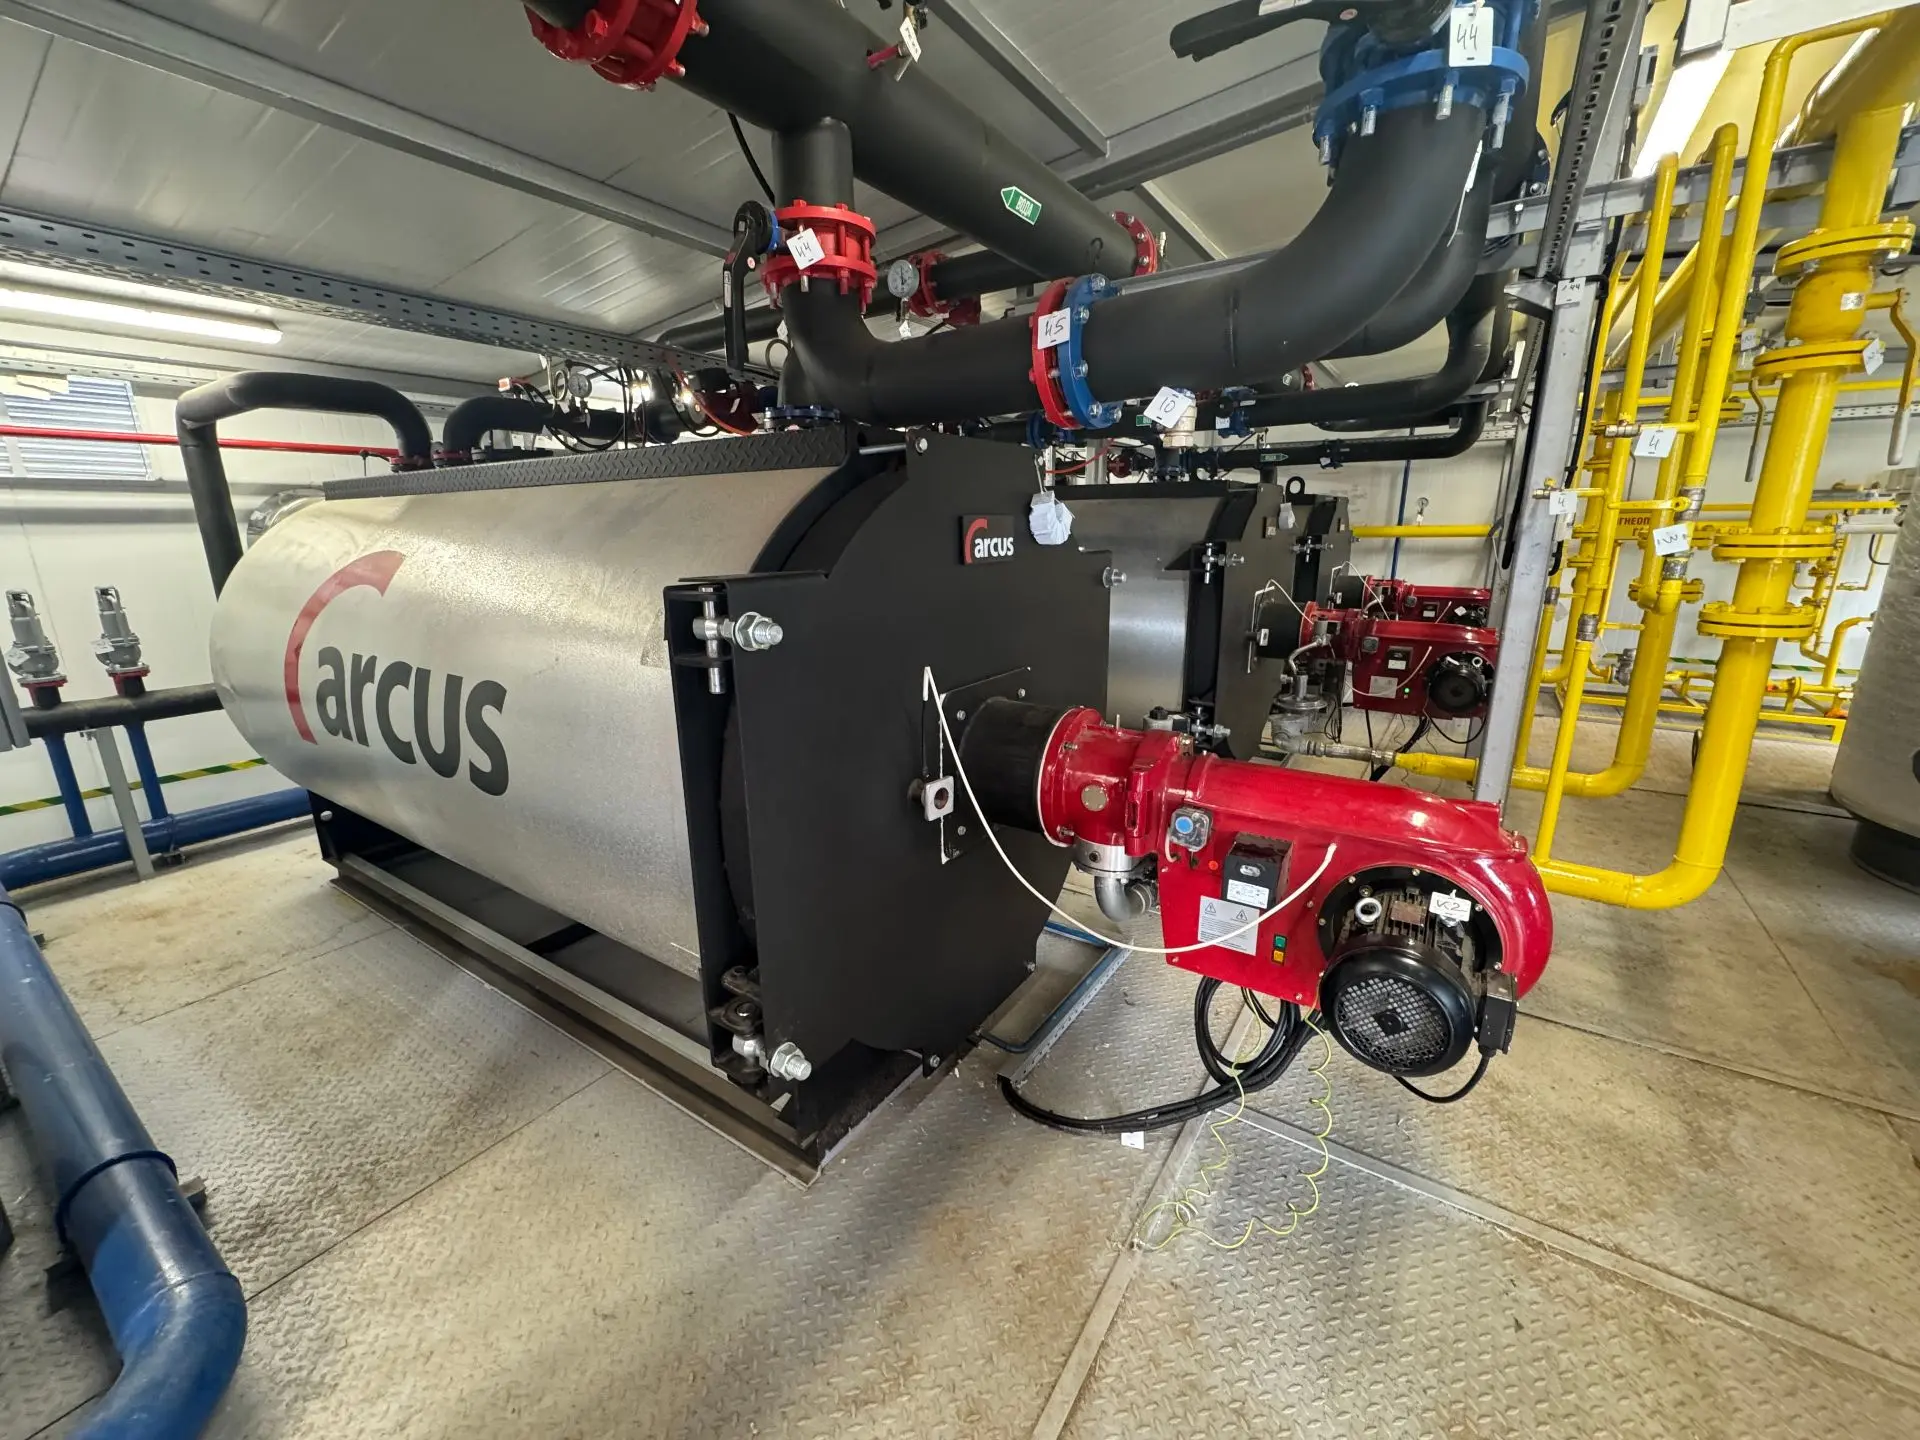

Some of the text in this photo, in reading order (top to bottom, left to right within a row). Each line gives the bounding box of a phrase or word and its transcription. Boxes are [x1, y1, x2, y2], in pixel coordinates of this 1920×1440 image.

[1457, 24, 1477, 51] 44
[794, 241, 812, 258] 44
[1045, 316, 1067, 336] 45
[1159, 397, 1176, 413] 10
[1648, 435, 1660, 451] 4
[974, 537, 1014, 558] arcus
[316, 646, 509, 796] arcus
